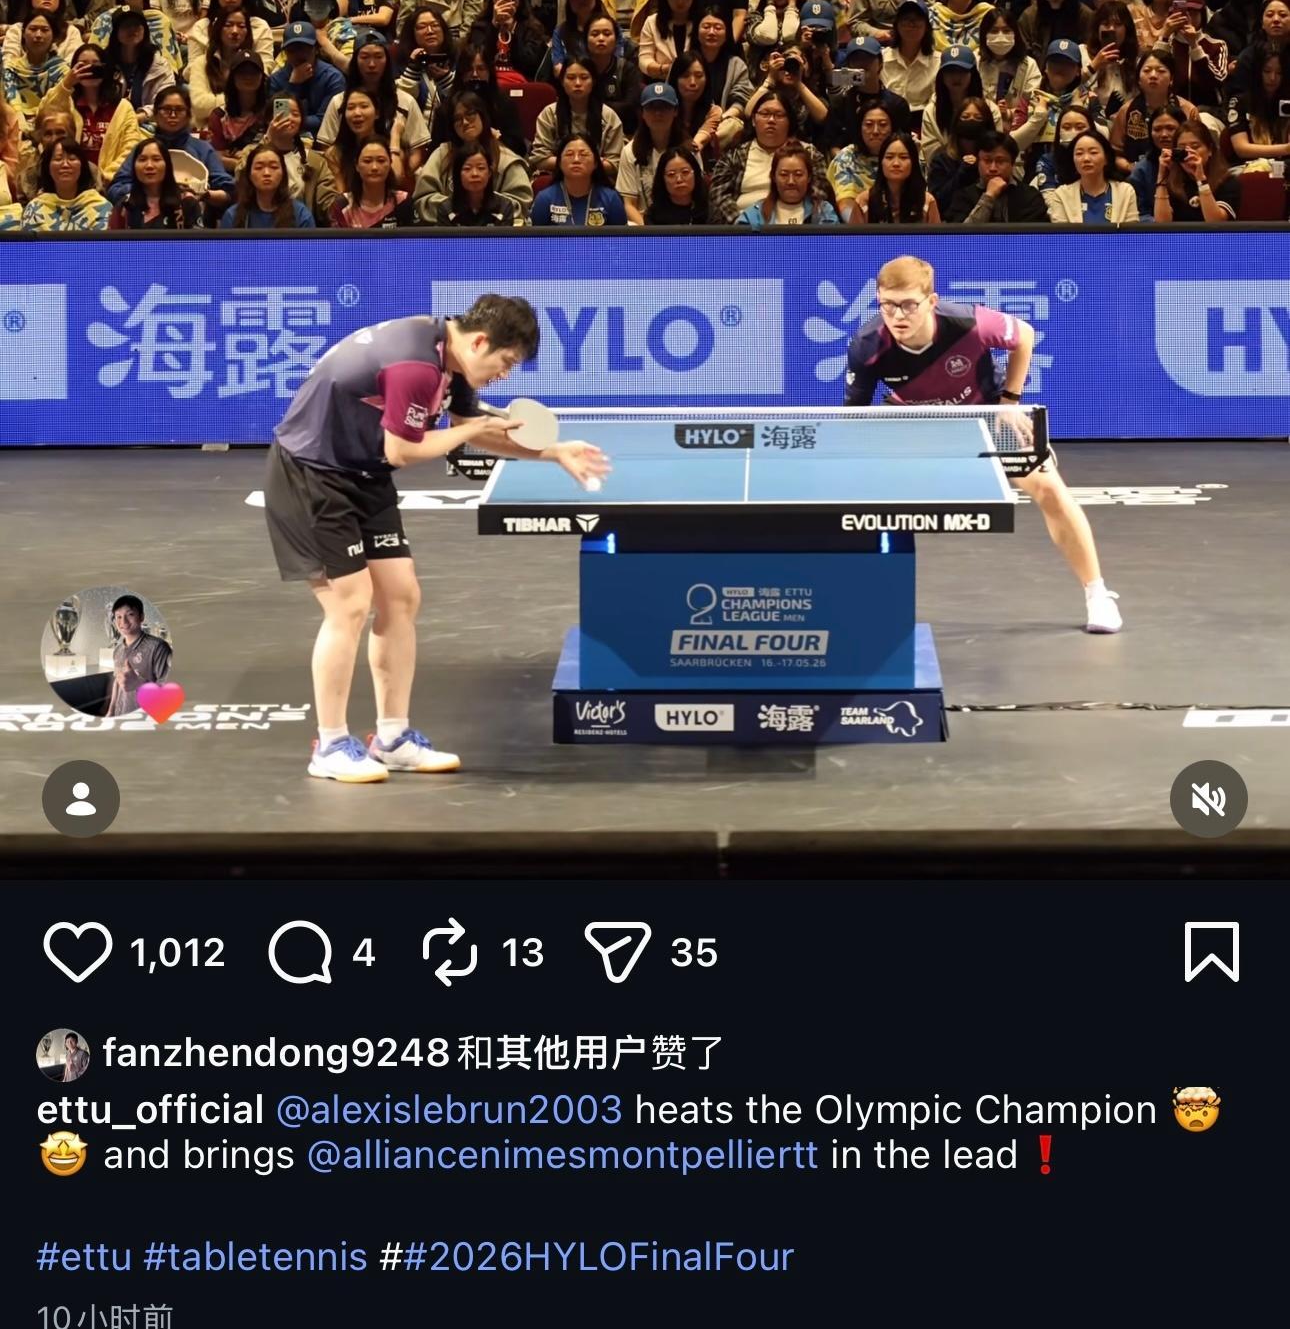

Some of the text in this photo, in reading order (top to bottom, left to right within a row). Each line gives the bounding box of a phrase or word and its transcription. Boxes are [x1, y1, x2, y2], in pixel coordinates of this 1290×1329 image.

[522, 305, 742, 374] YLO®
[685, 428, 740, 445] HYLO
[761, 425, 817, 450] 海露
[503, 517, 571, 533] TIBHAR
[841, 513, 991, 531] EVOLUTION MX-D
[785, 588, 812, 597] ETTU
[721, 599, 812, 610] CHAMPIONS
[723, 611, 805, 622] LEAGUE MEN
[678, 634, 821, 651] FINAL FOUR
[670, 655, 752, 667] SAARBRÜCKEN
[666, 710, 719, 726] HYLO
[757, 704, 814, 732] 海露
[840, 707, 868, 716] TEAM
[840, 716, 895, 725] SAARLAND
